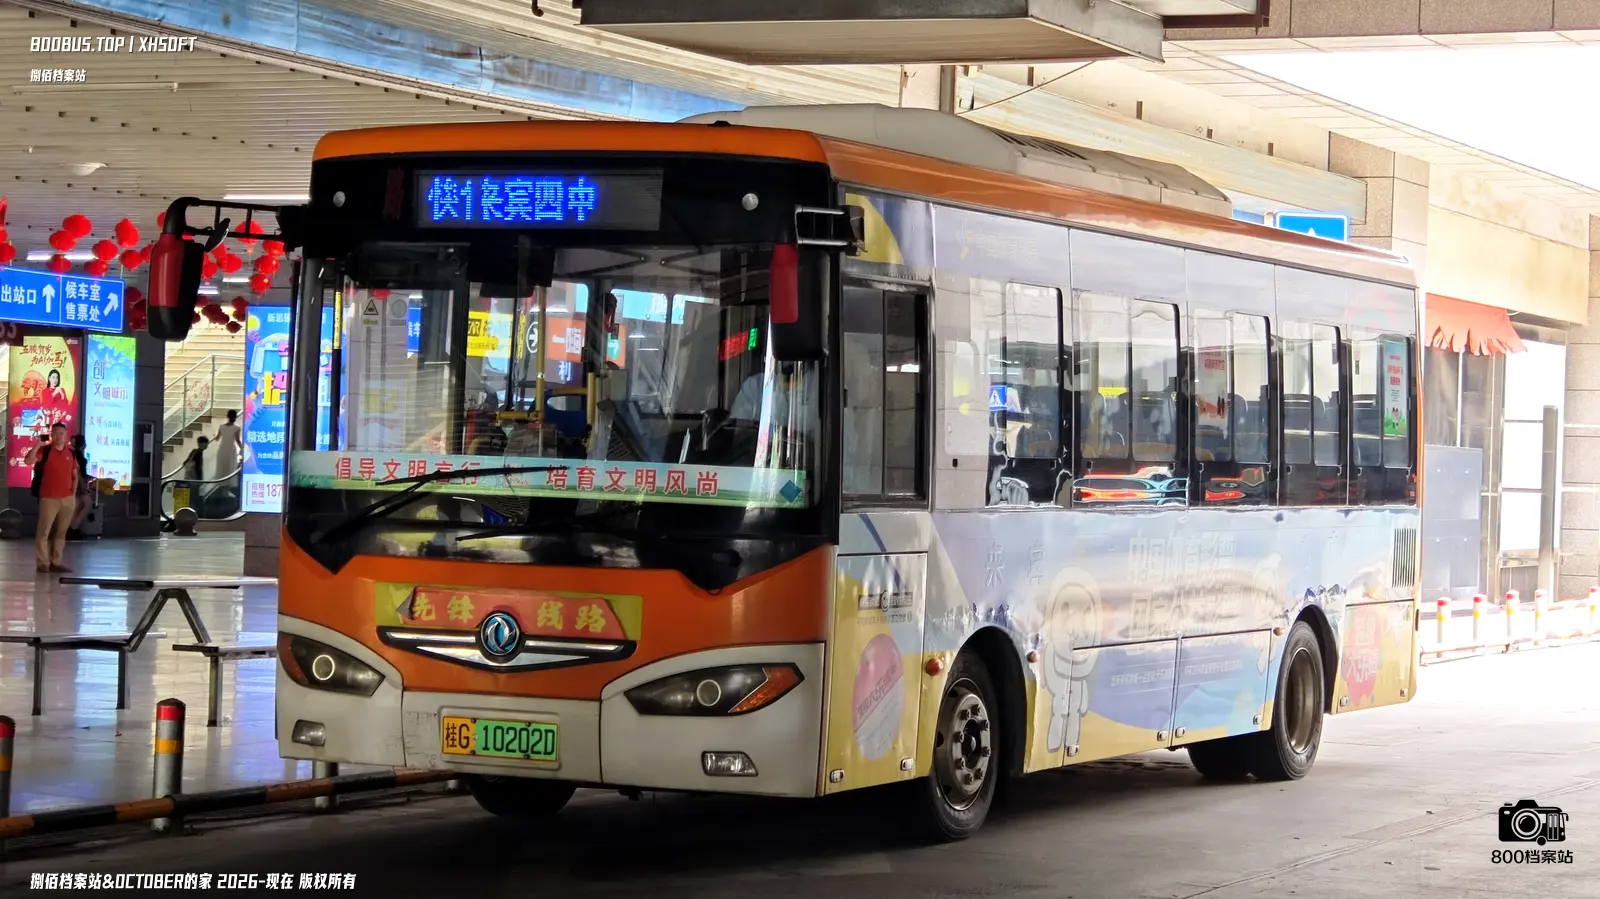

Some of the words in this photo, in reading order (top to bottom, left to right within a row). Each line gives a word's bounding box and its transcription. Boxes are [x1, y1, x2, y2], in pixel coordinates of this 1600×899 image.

[1, 284, 37, 305] 出站口
[65, 281, 101, 302] 候车室
[65, 302, 100, 323] 售票处
[546, 464, 718, 496] 培育文明风尚
[412, 592, 476, 624] 先锋
[536, 599, 606, 631] 线路
[445, 722, 471, 749] 桂G
[481, 724, 556, 757] 10202D
